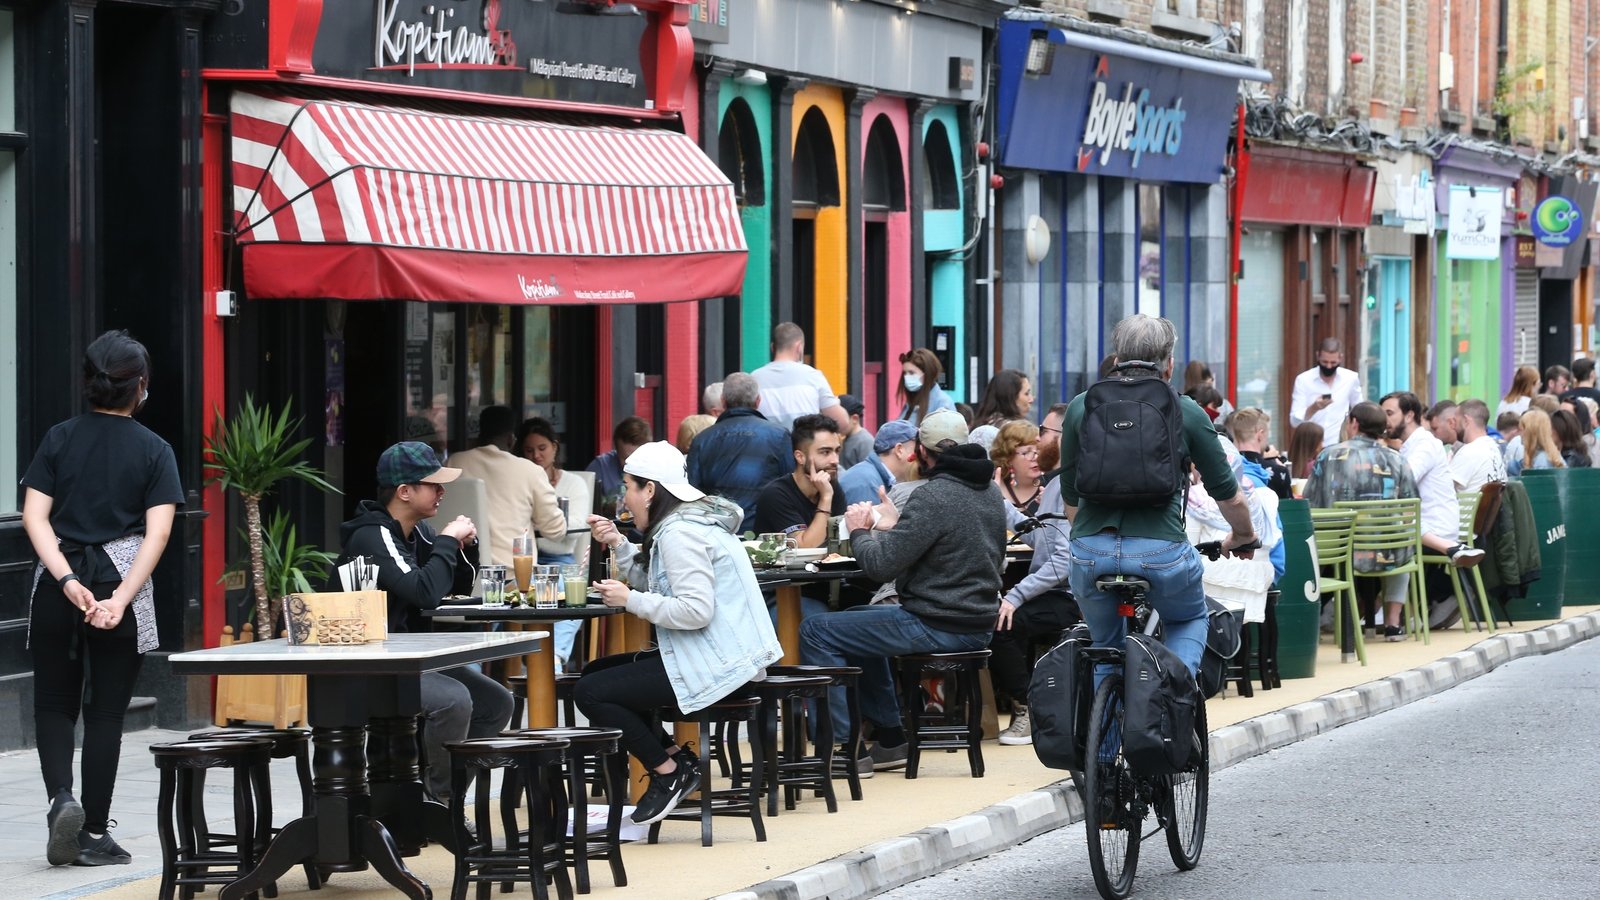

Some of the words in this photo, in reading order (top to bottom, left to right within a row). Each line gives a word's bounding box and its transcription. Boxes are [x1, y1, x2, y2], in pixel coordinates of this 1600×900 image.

[375, 0, 495, 77] Kopitiam
[531, 58, 560, 79] Malaysian
[562, 61, 578, 78] Street
[578, 63, 593, 80] Food
[606, 67, 617, 83] and
[618, 67, 636, 88] Gallery
[1083, 81, 1186, 169] BoyleSports
[1450, 232, 1496, 244] YumCha
[518, 274, 559, 301] Kopitiam
